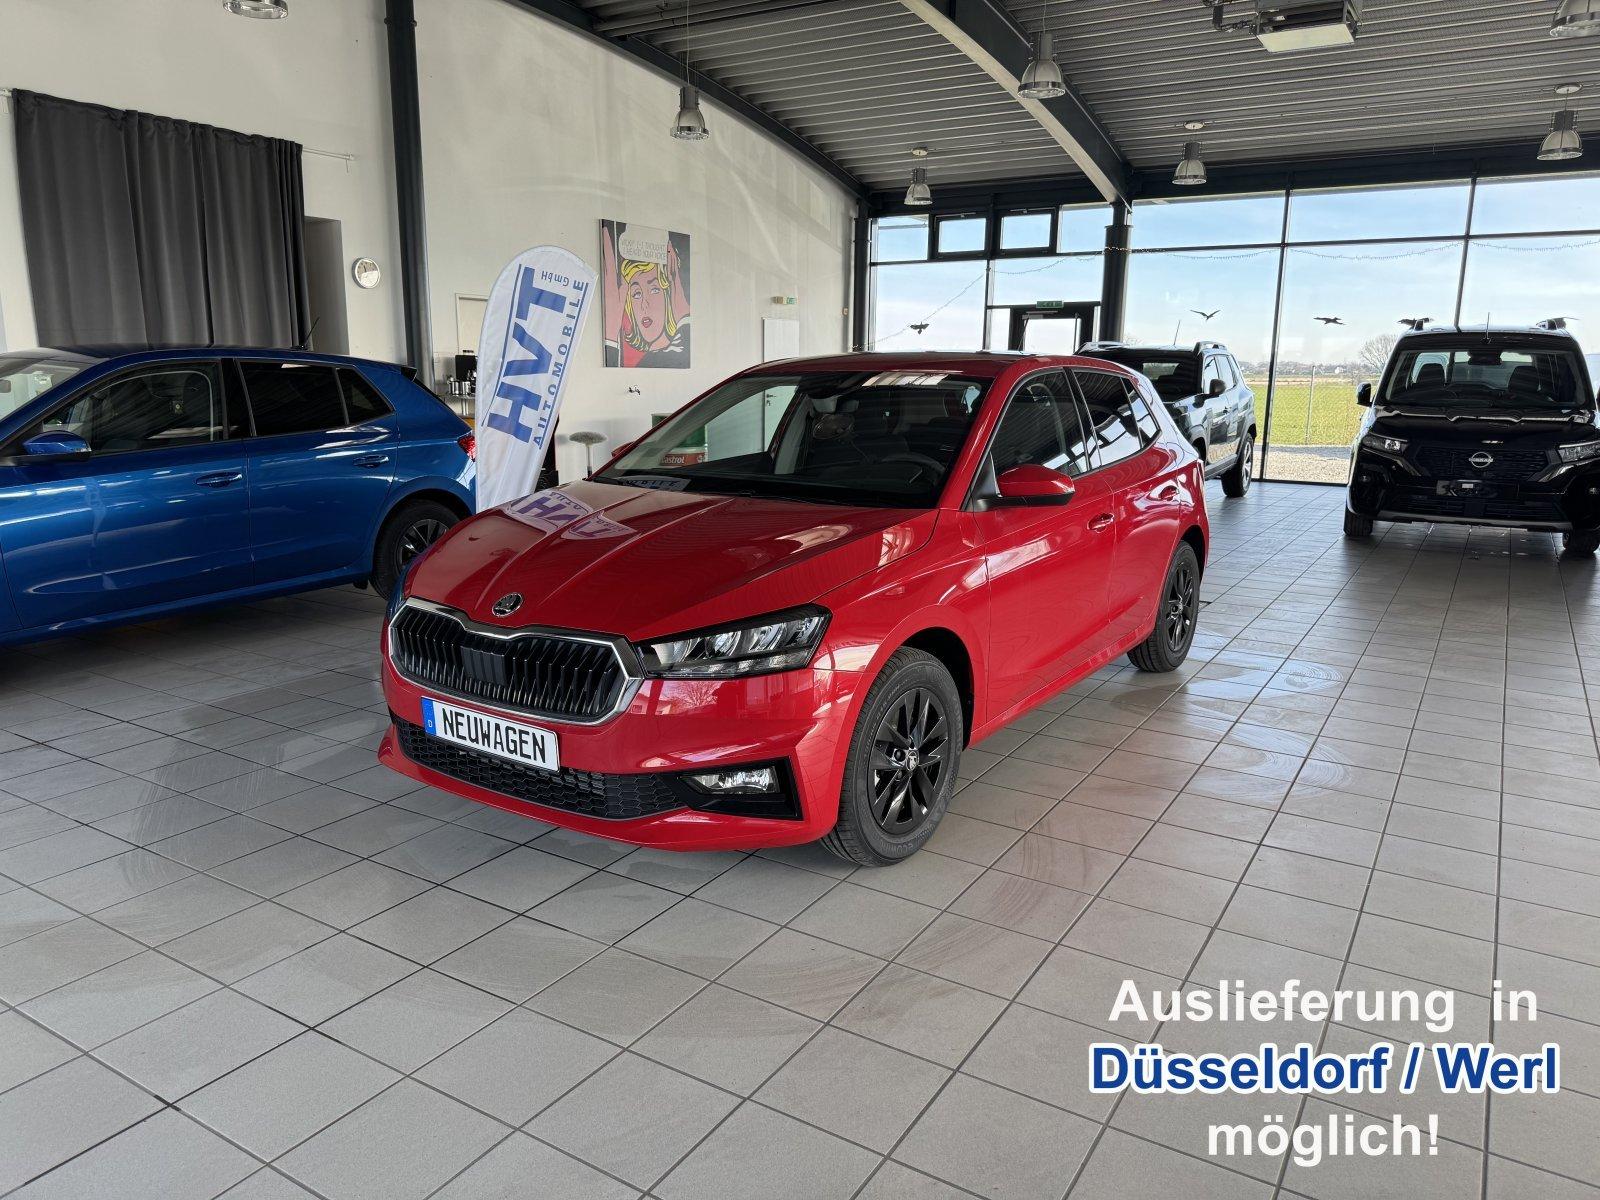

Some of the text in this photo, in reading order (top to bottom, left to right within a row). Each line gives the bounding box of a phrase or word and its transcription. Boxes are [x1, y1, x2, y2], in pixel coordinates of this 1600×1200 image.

[541, 269, 570, 288] GmbH
[487, 266, 567, 444] HVT
[532, 279, 585, 450] AUTOMOBILE
[442, 707, 547, 764] NEUWAGEN
